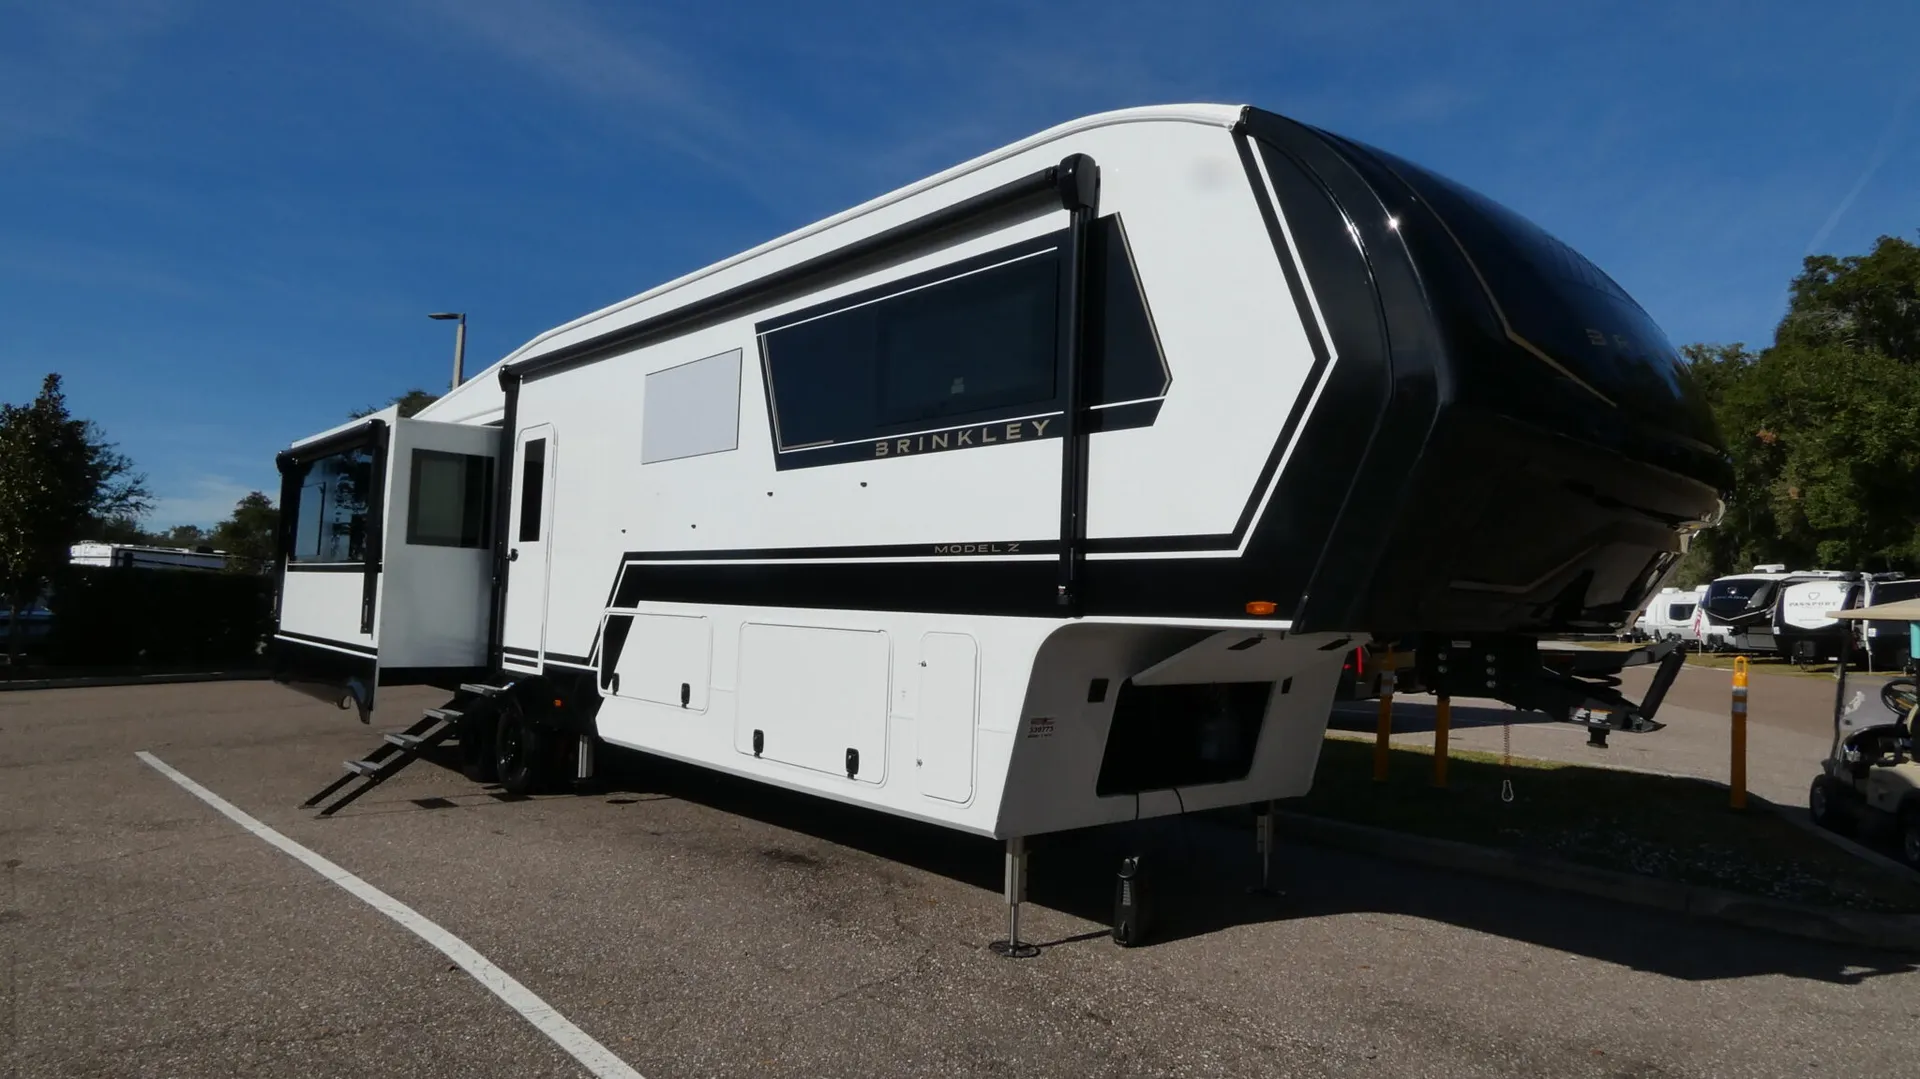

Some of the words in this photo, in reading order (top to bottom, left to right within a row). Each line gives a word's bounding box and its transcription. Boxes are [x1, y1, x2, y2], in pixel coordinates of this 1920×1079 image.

[875, 419, 1050, 457] BRINKLEY
[934, 543, 1002, 554] MODEL
[1007, 543, 1020, 552] Z
